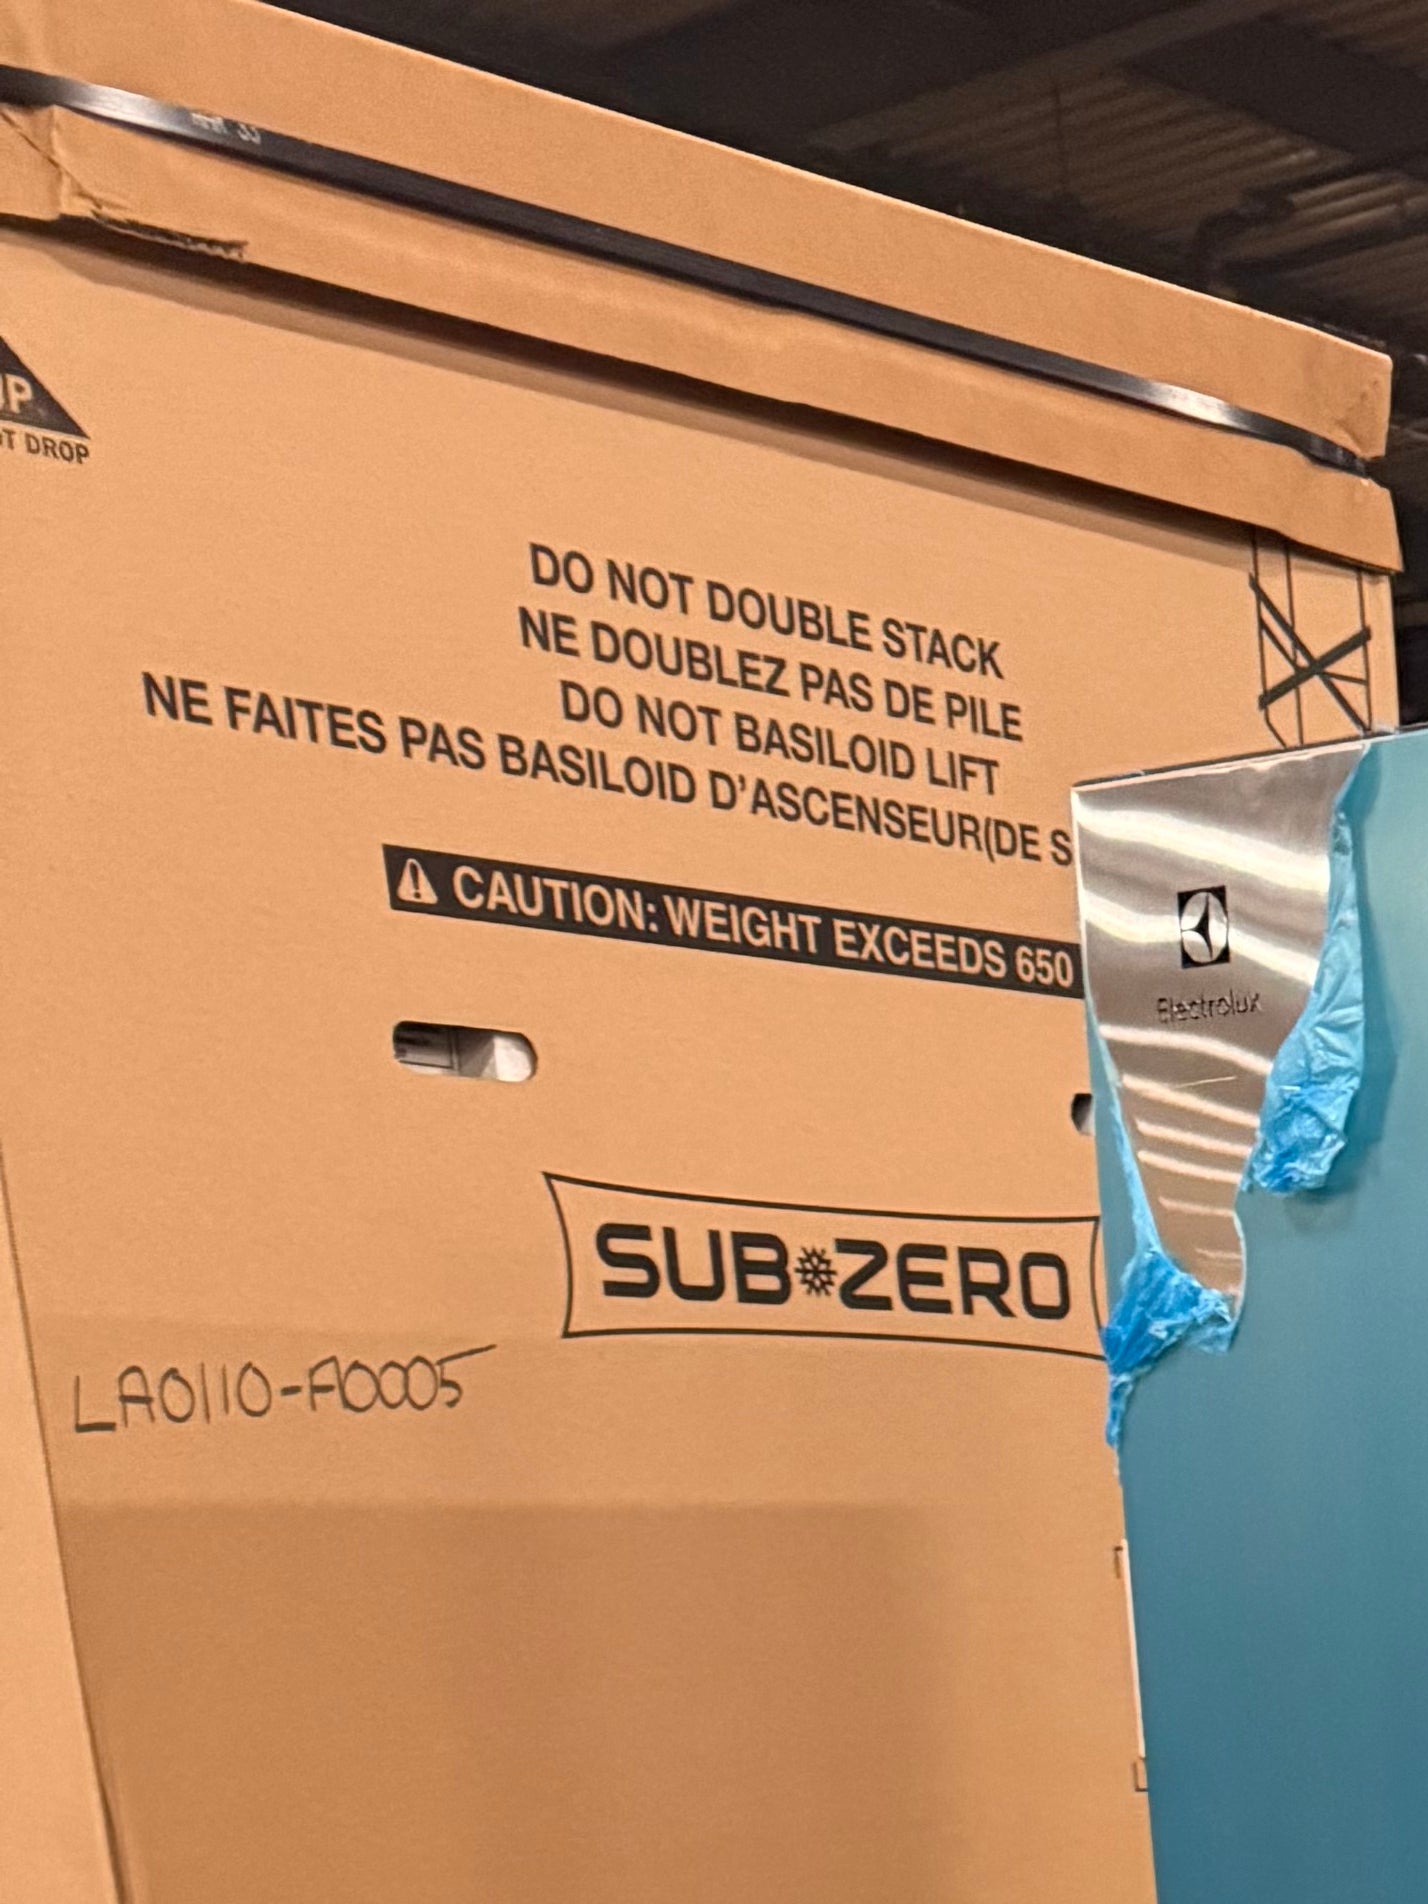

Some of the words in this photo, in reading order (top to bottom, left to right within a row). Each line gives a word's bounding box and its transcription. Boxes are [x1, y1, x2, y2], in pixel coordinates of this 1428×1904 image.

[0, 372, 33, 415] P
[24, 432, 90, 465] DROP
[529, 541, 594, 595] DO
[606, 558, 694, 615] NOT
[706, 579, 873, 653] DOUBLE
[882, 617, 1005, 680] STACK
[518, 605, 580, 658] NE
[591, 619, 791, 698] DOUBLEZ
[800, 661, 875, 714] PAS
[884, 677, 936, 725] DE
[945, 690, 1024, 743] PILE
[141, 670, 213, 727] NE
[223, 684, 388, 755] FAITES
[398, 715, 486, 771] PAS
[497, 732, 697, 804] BASILOID
[560, 678, 623, 730] DO
[635, 693, 721, 747] NOT
[734, 711, 916, 781] BASILOID
[926, 747, 1000, 796] LIFT
[451, 864, 659, 934] CAUTION:
[662, 893, 823, 955] WEIGHT
[832, 917, 1008, 980] EXCEEDS
[1014, 945, 1075, 989] 650
[1155, 987, 1263, 1025] Electrolux
